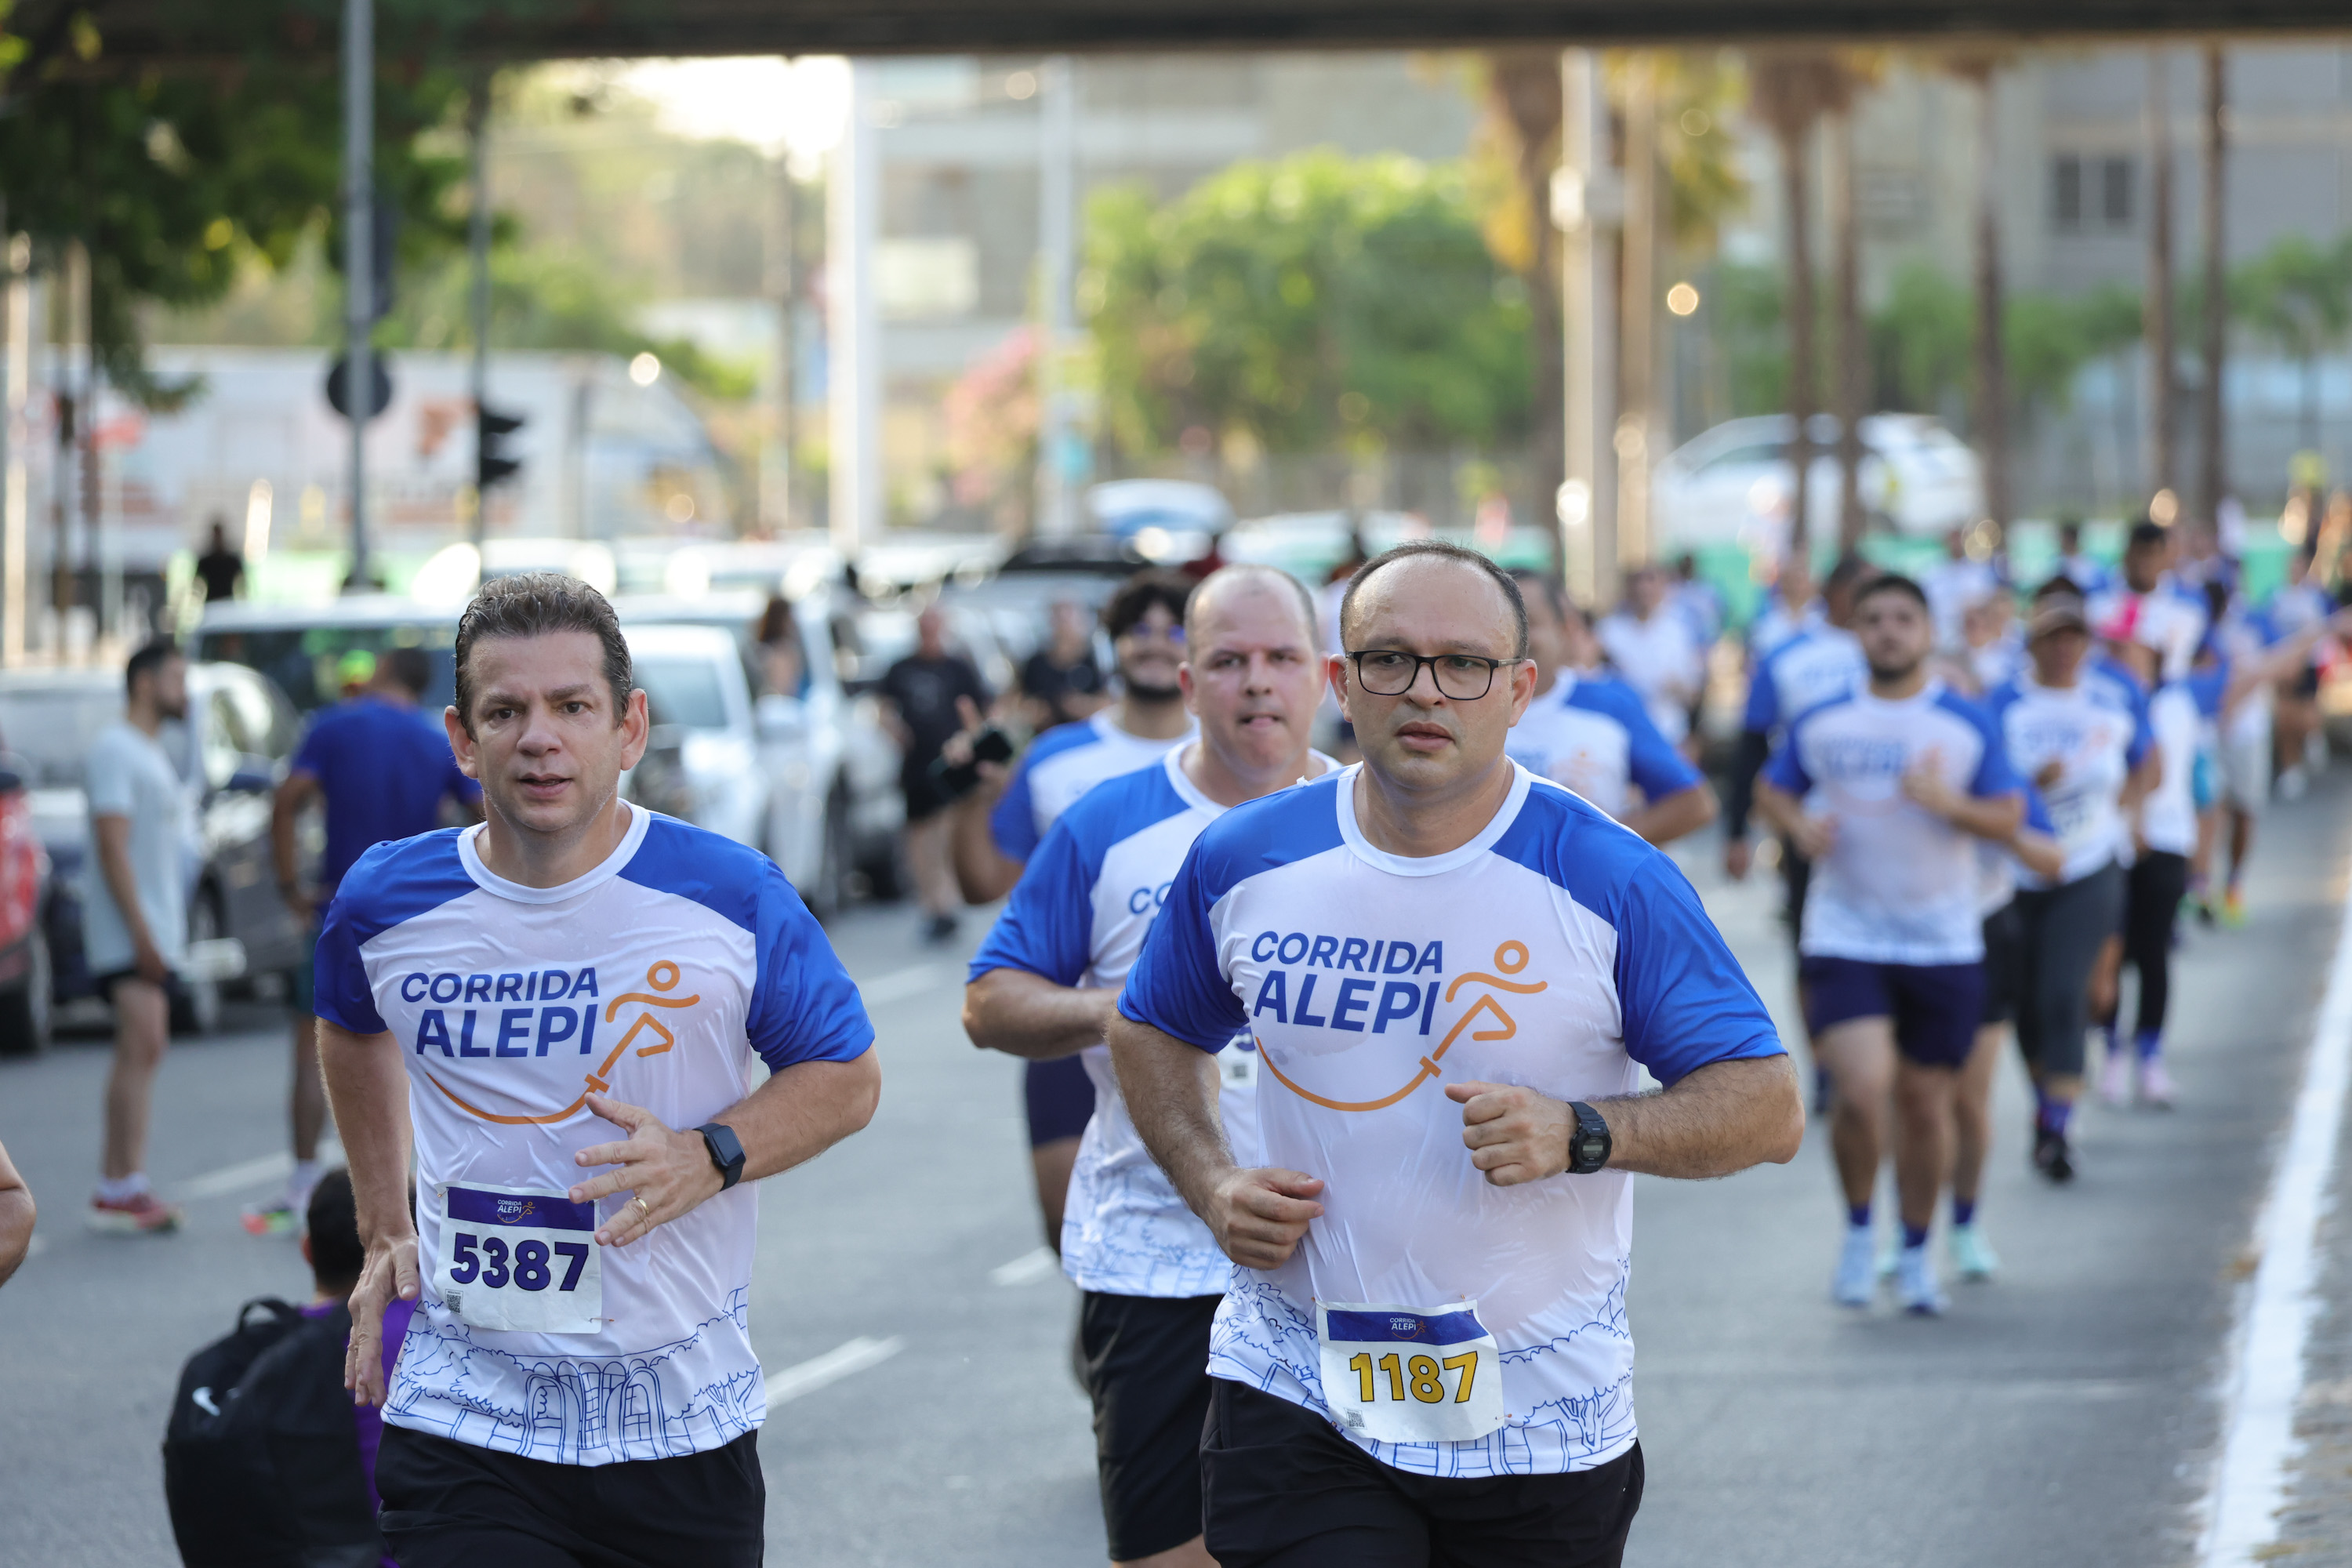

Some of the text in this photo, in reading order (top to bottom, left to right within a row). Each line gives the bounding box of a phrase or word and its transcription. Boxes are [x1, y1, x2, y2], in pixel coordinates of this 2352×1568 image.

[1251, 931, 1443, 975] CORRIDA
[401, 967, 599, 1004] CORRIDA
[1254, 970, 1441, 1035] ALEPI
[416, 1004, 598, 1058] ALEPI
[497, 1205, 522, 1214] ALEPI
[450, 1232, 590, 1292] 5387
[1349, 1350, 1479, 1404] 1187
